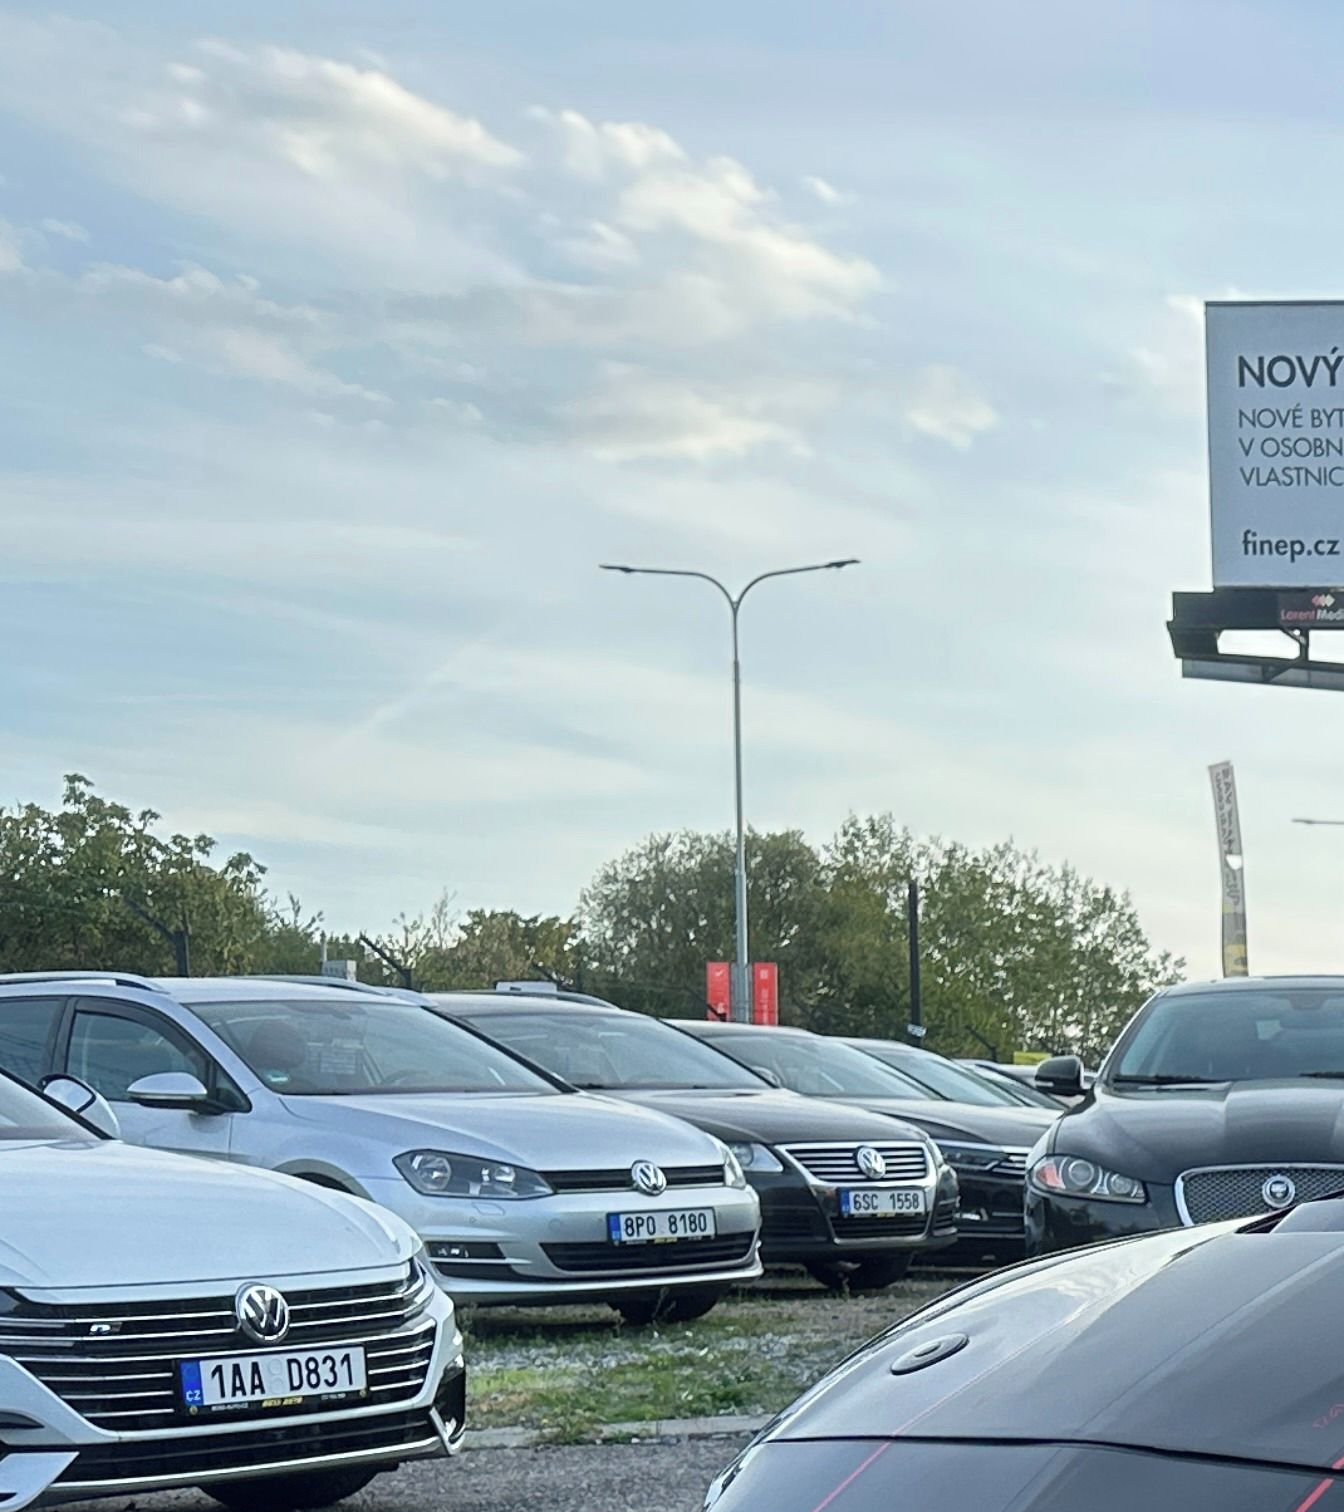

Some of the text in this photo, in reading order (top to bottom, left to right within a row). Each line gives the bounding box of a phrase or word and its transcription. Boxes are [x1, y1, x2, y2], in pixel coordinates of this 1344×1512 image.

[1237, 346, 1344, 388] NOVÝ
[1238, 403, 1304, 429] NOVÉ
[1238, 437, 1256, 457] V
[1242, 529, 1341, 563] finep.cz
[667, 1212, 707, 1234] 8180
[211, 1353, 354, 1398] 1AA D831
[185, 1389, 202, 1402] CZ
